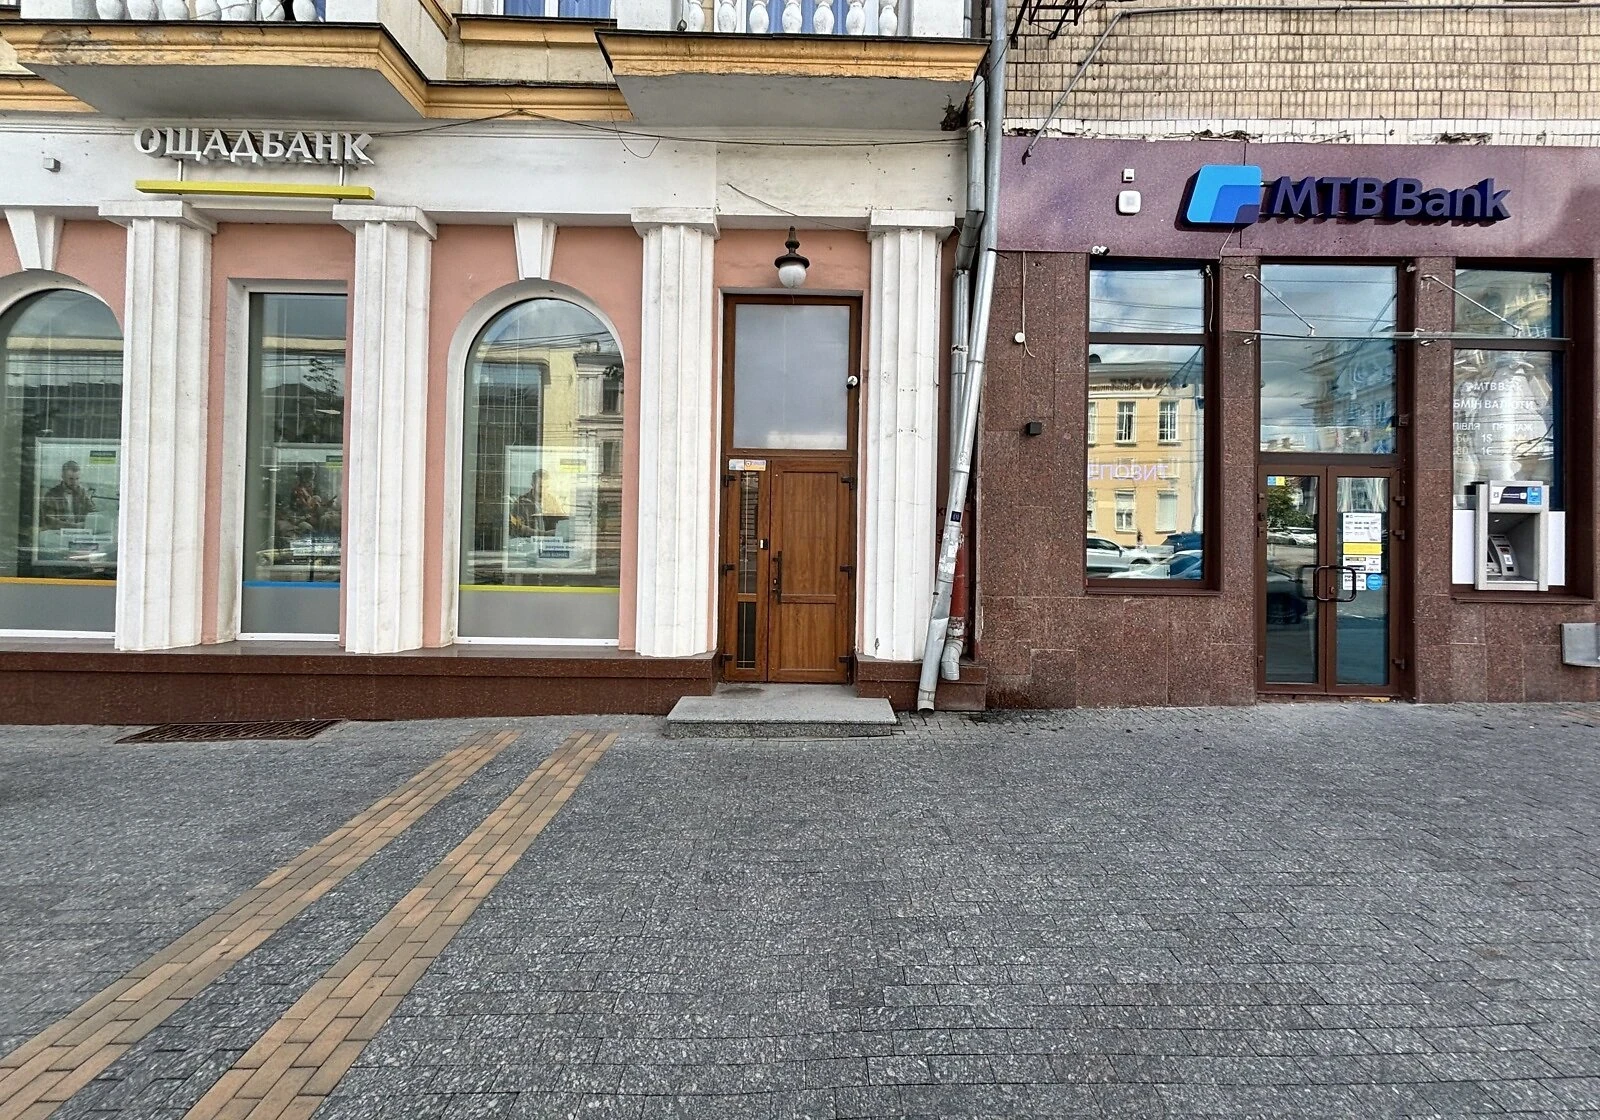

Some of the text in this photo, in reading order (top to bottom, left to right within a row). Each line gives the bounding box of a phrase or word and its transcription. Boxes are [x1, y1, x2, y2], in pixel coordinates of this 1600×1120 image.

[134, 126, 375, 165] ОЩАДБАНК
[1273, 176, 1511, 218] MTB Bank
